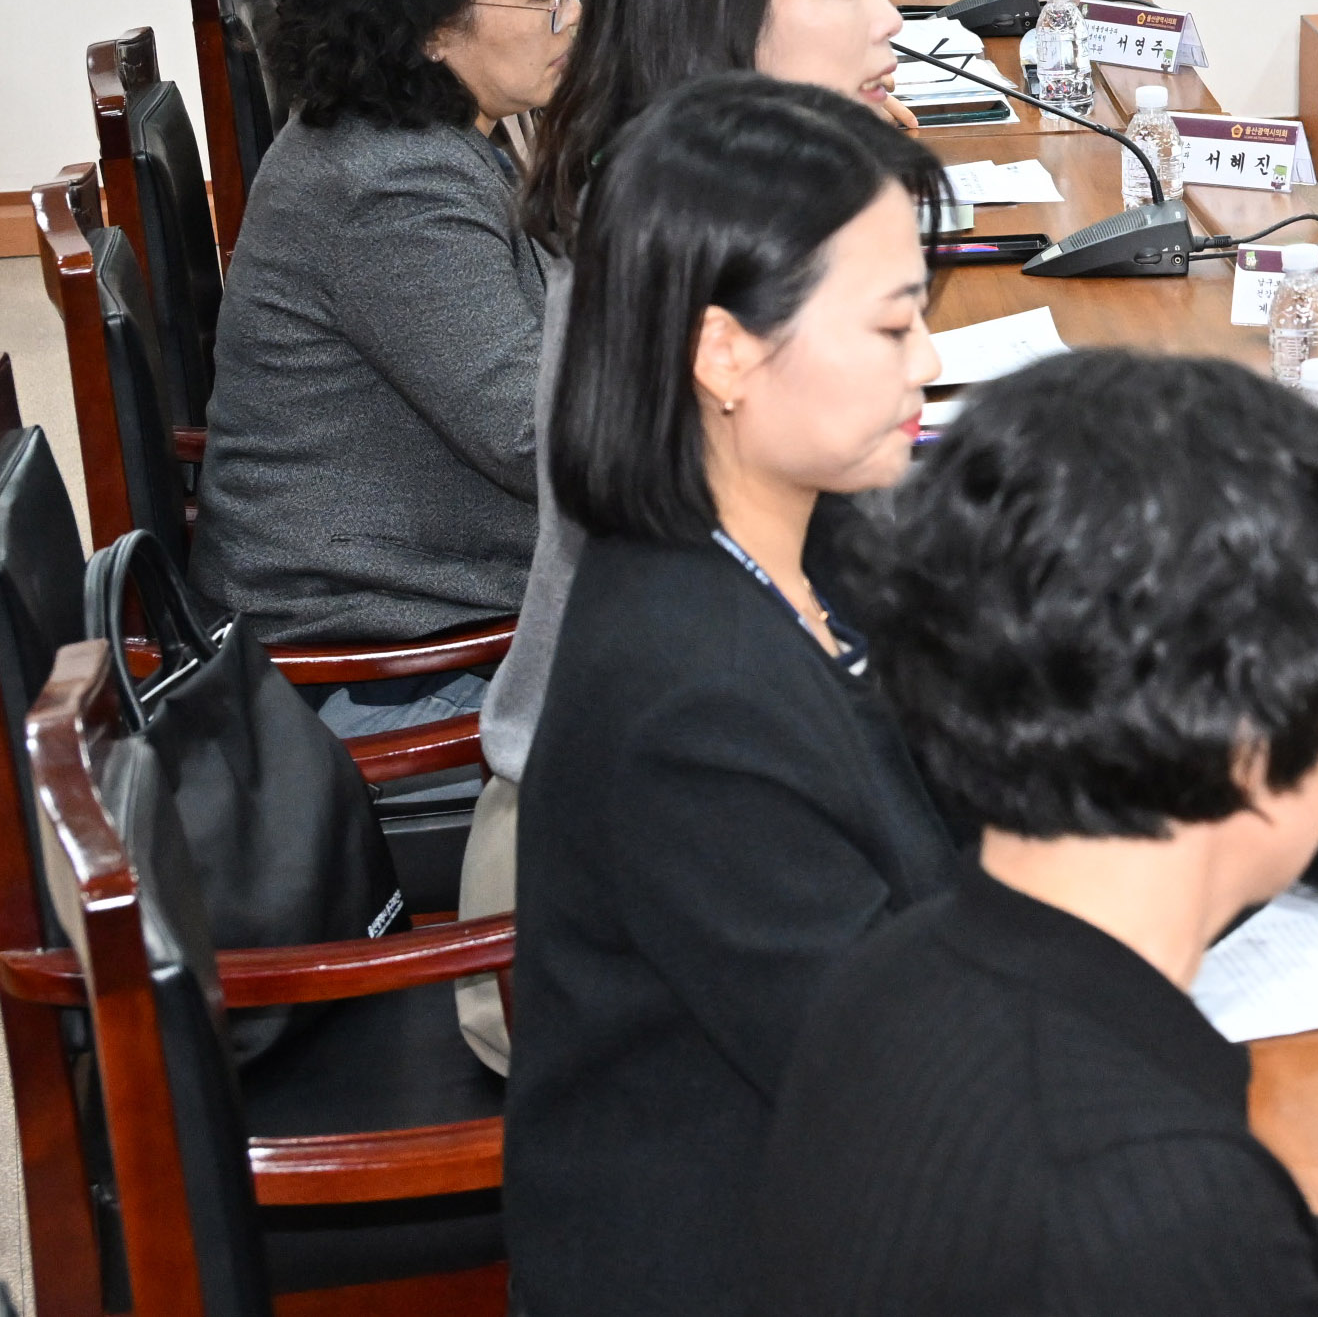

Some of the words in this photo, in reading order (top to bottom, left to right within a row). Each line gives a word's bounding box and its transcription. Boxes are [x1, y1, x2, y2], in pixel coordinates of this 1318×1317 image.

[1116, 35, 1164, 59] 서영주
[1245, 126, 1288, 138] 울산광역시의회
[1204, 149, 1271, 176] 서혜진
